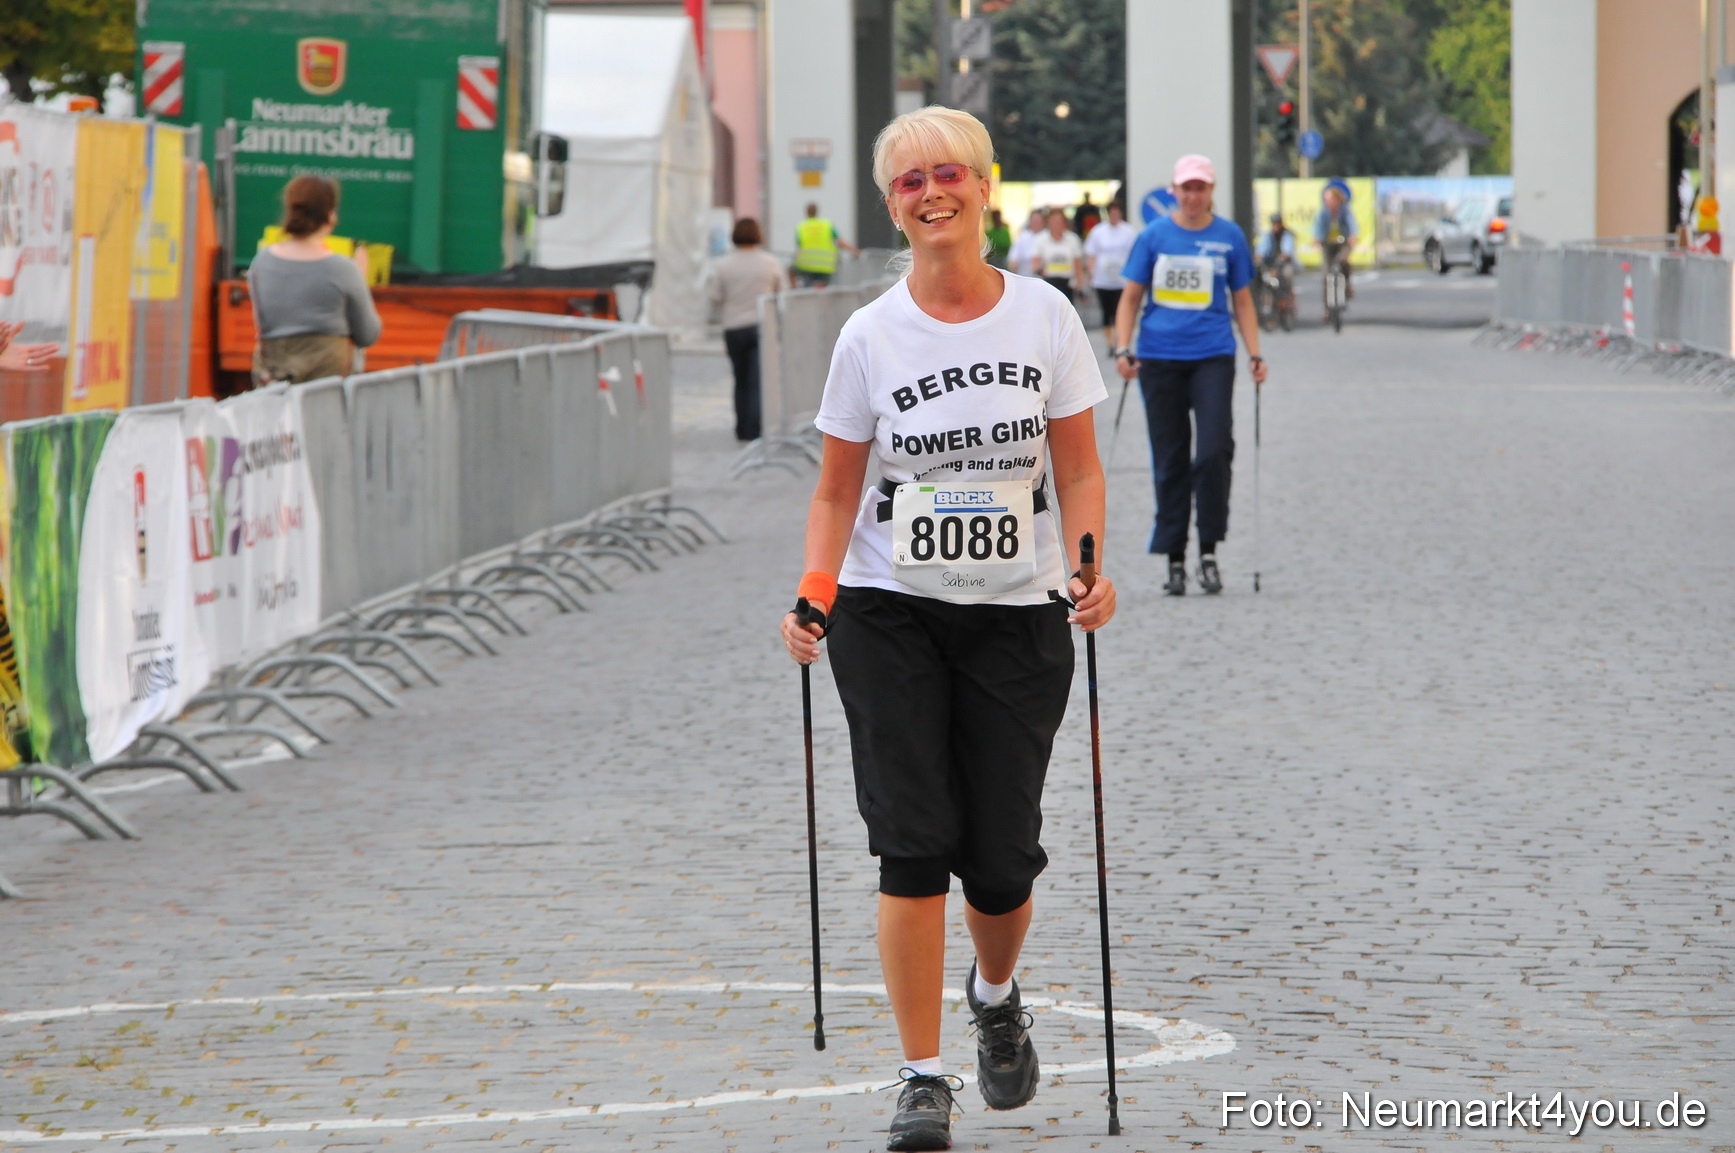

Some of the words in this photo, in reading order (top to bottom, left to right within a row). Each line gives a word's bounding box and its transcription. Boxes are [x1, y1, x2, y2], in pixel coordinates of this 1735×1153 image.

[252, 98, 391, 126] Neumarkter
[1165, 269, 1201, 289] 865
[892, 361, 1042, 413] BERGER
[892, 426, 983, 456] POWER
[968, 458, 994, 471] and
[934, 491, 994, 504] BOCK
[910, 514, 1019, 561] 8088
[941, 572, 985, 588] Sabine
